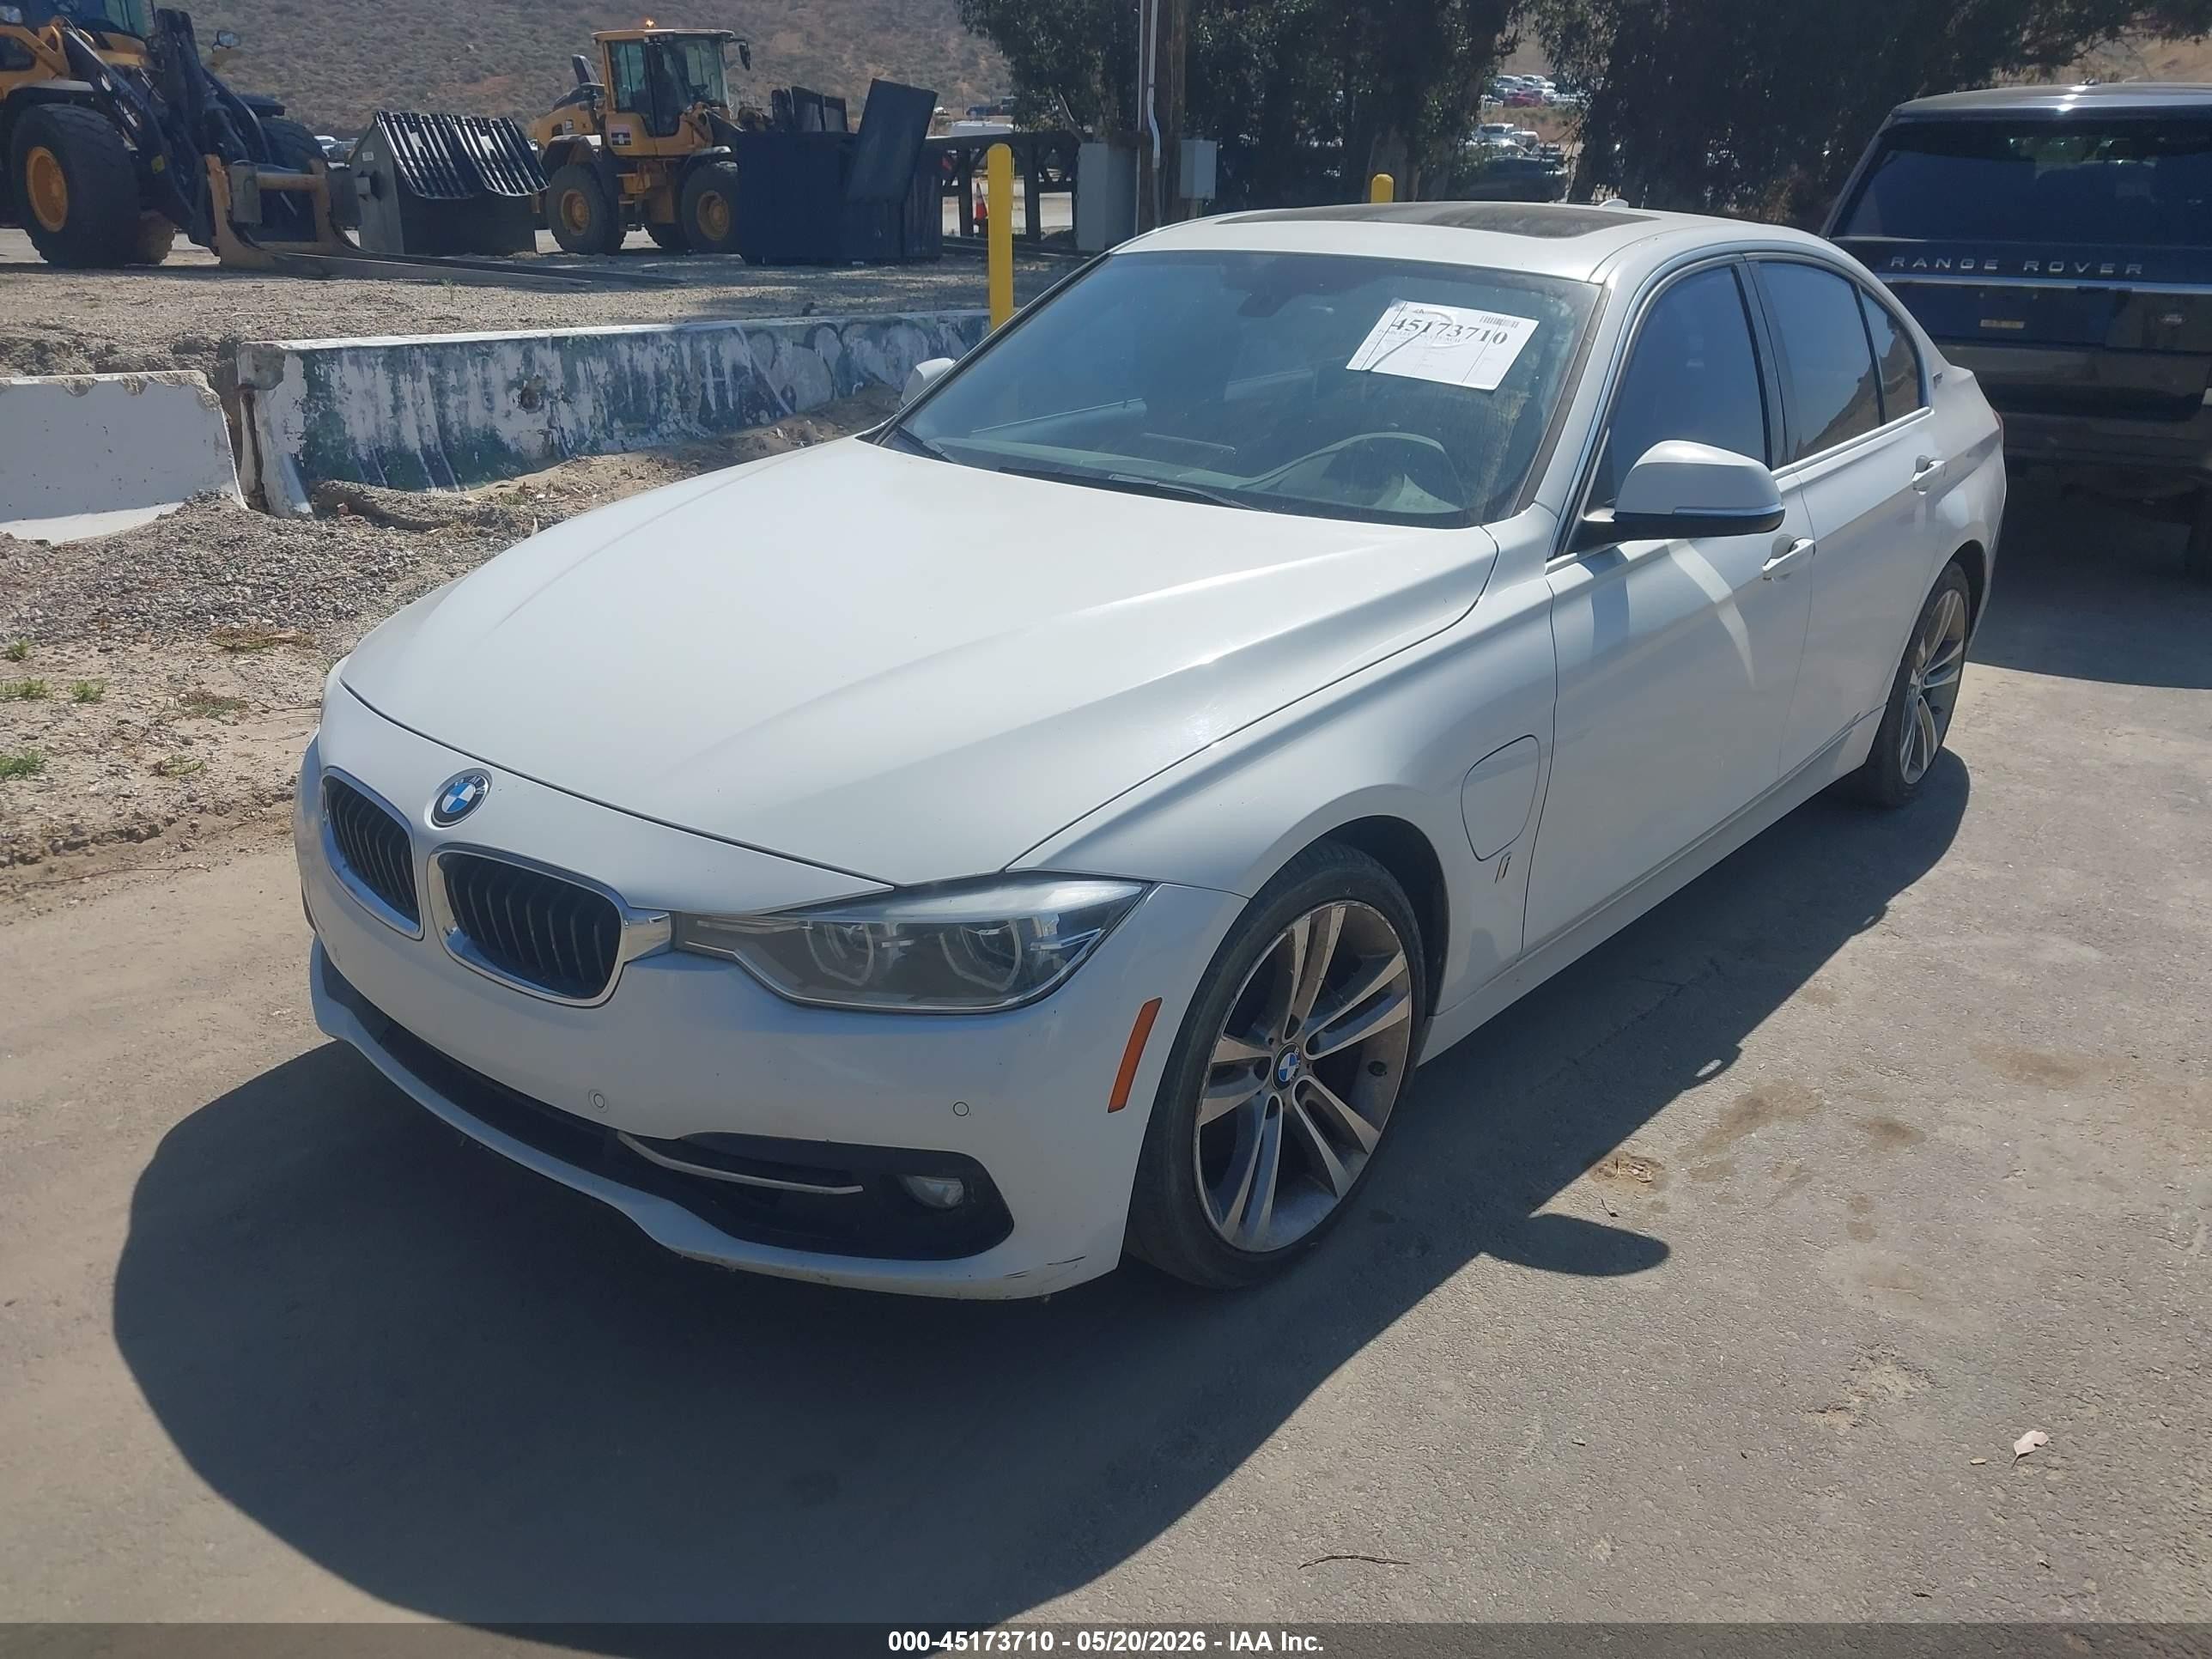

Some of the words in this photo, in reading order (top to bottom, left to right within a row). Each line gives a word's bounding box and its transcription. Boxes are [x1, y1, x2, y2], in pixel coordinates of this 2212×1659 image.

[1891, 257, 1999, 270] RANGE
[2023, 260, 2142, 274] ROVER
[1391, 319, 1508, 344] 45173710
